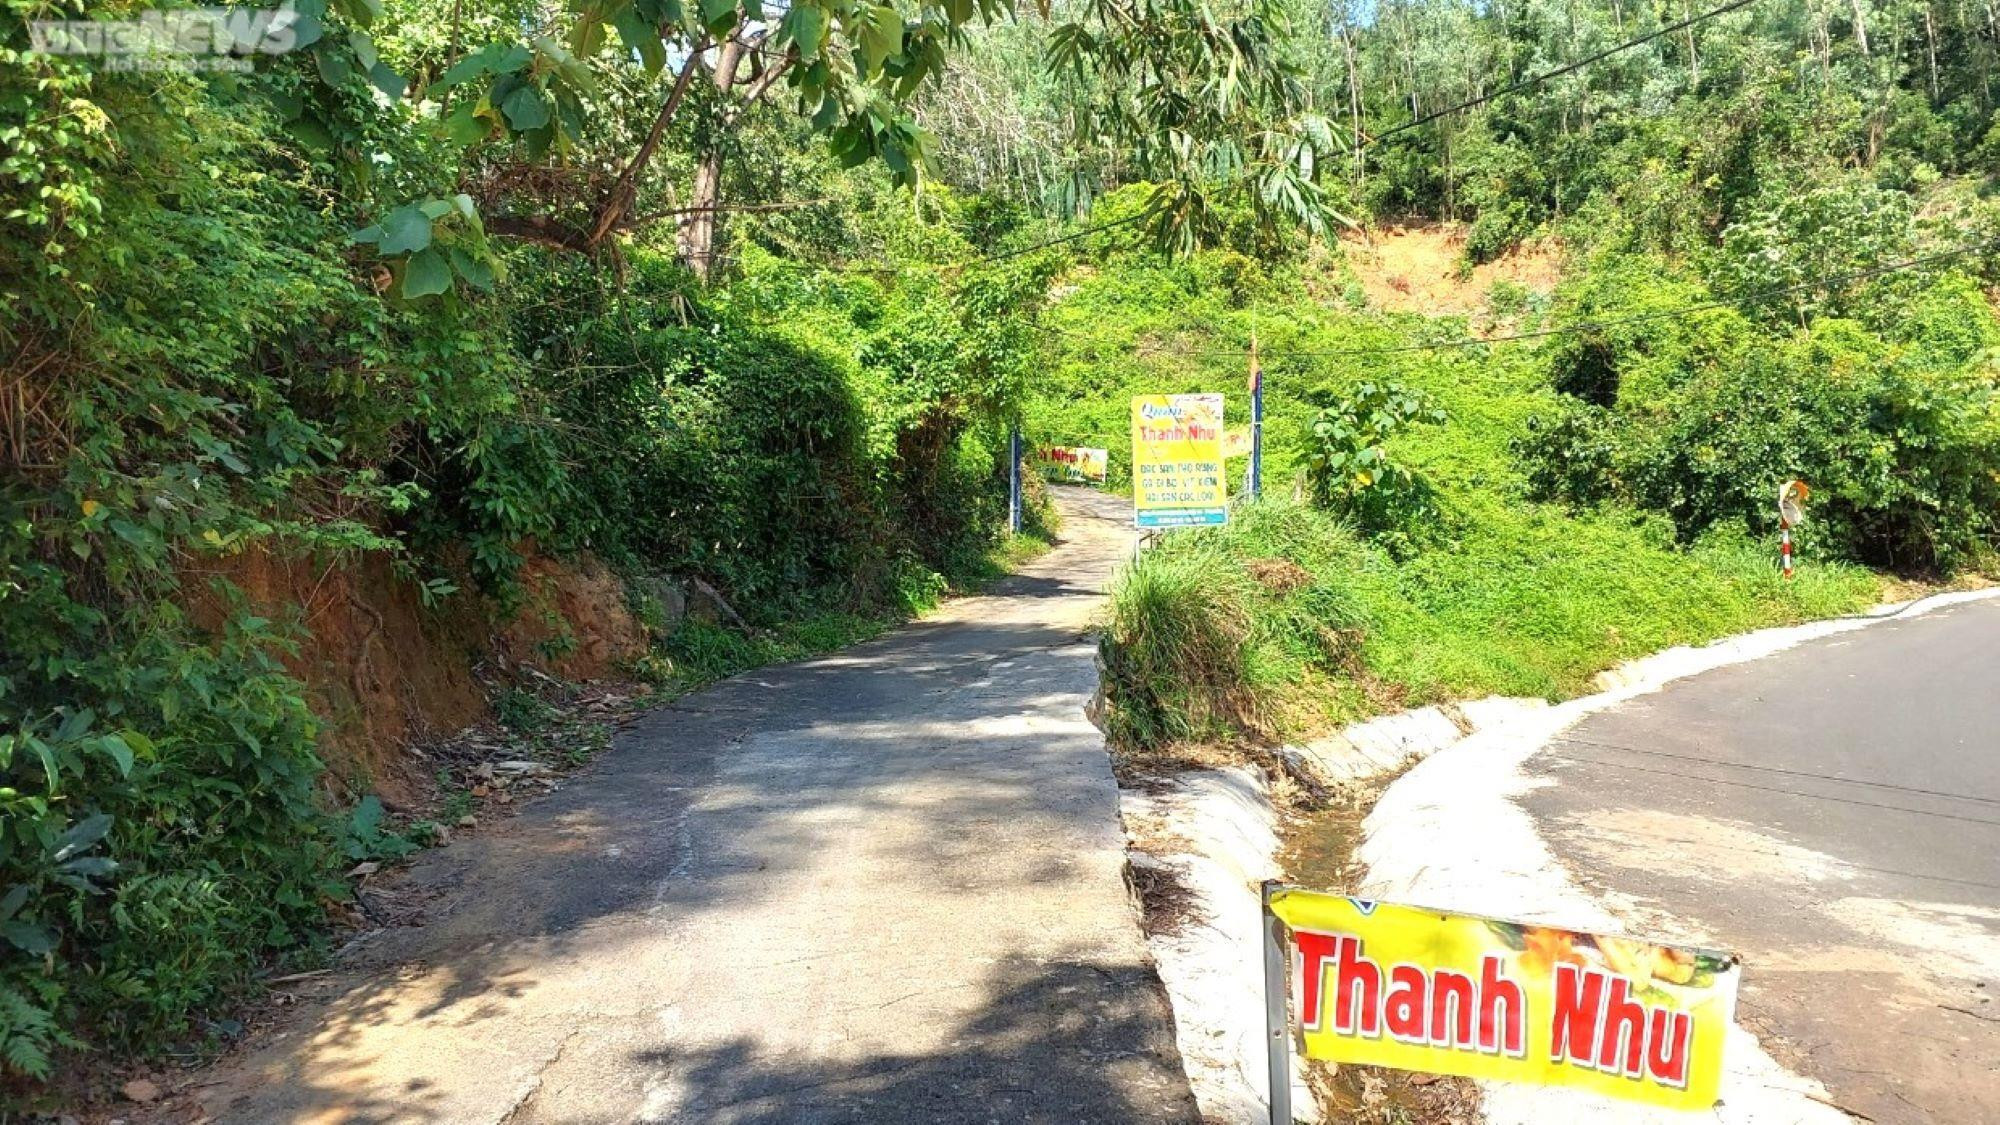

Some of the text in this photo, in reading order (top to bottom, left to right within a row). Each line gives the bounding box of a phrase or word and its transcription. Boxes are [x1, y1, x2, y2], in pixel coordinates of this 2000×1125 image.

[1139, 425, 1184, 441] Thanh
[1188, 424, 1216, 441] Nhu
[1293, 928, 1693, 1089] Thanh Nhu
